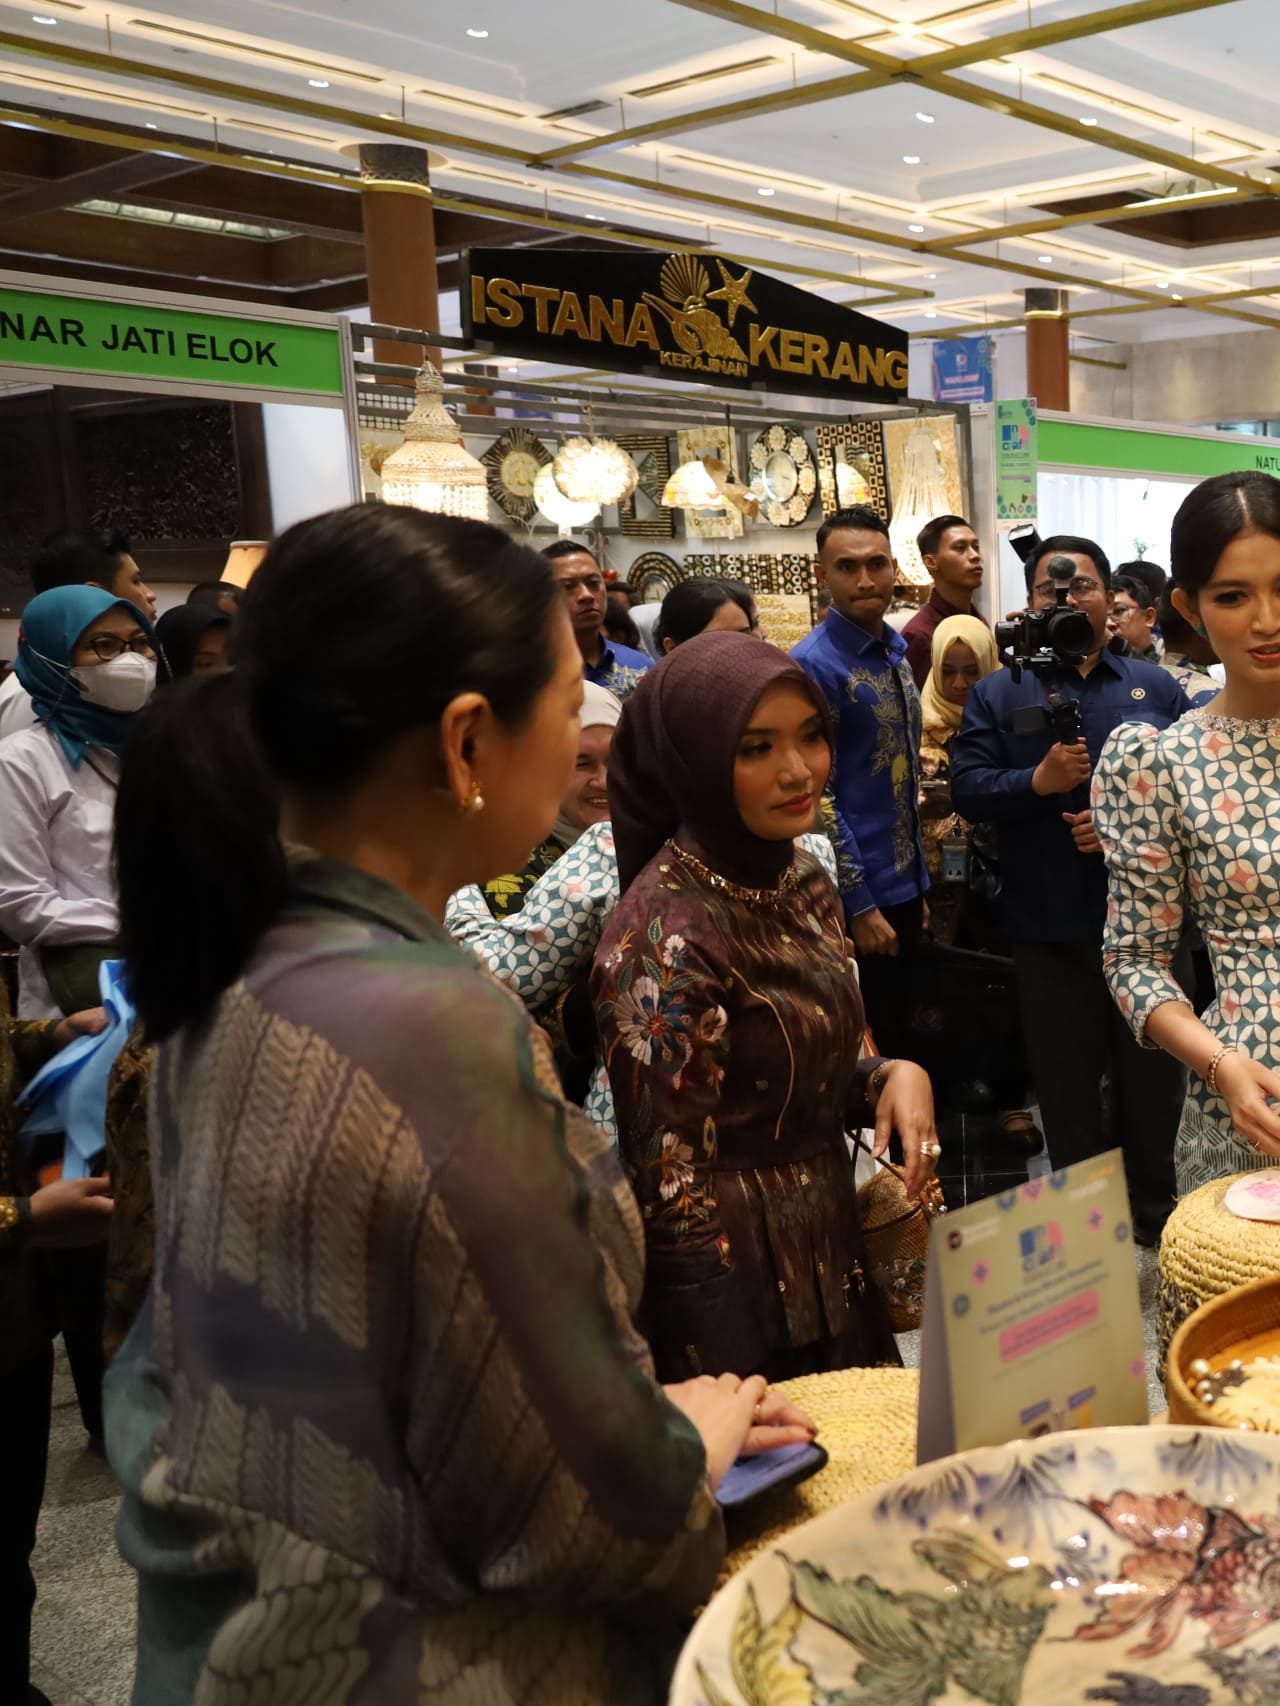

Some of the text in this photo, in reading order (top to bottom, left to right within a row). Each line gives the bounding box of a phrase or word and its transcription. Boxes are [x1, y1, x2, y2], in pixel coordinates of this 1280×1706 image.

[0, 311, 279, 367] NAR JATI ELOK
[471, 274, 908, 389] ISTANA KERANG
[659, 350, 748, 377] KERAJINAN
